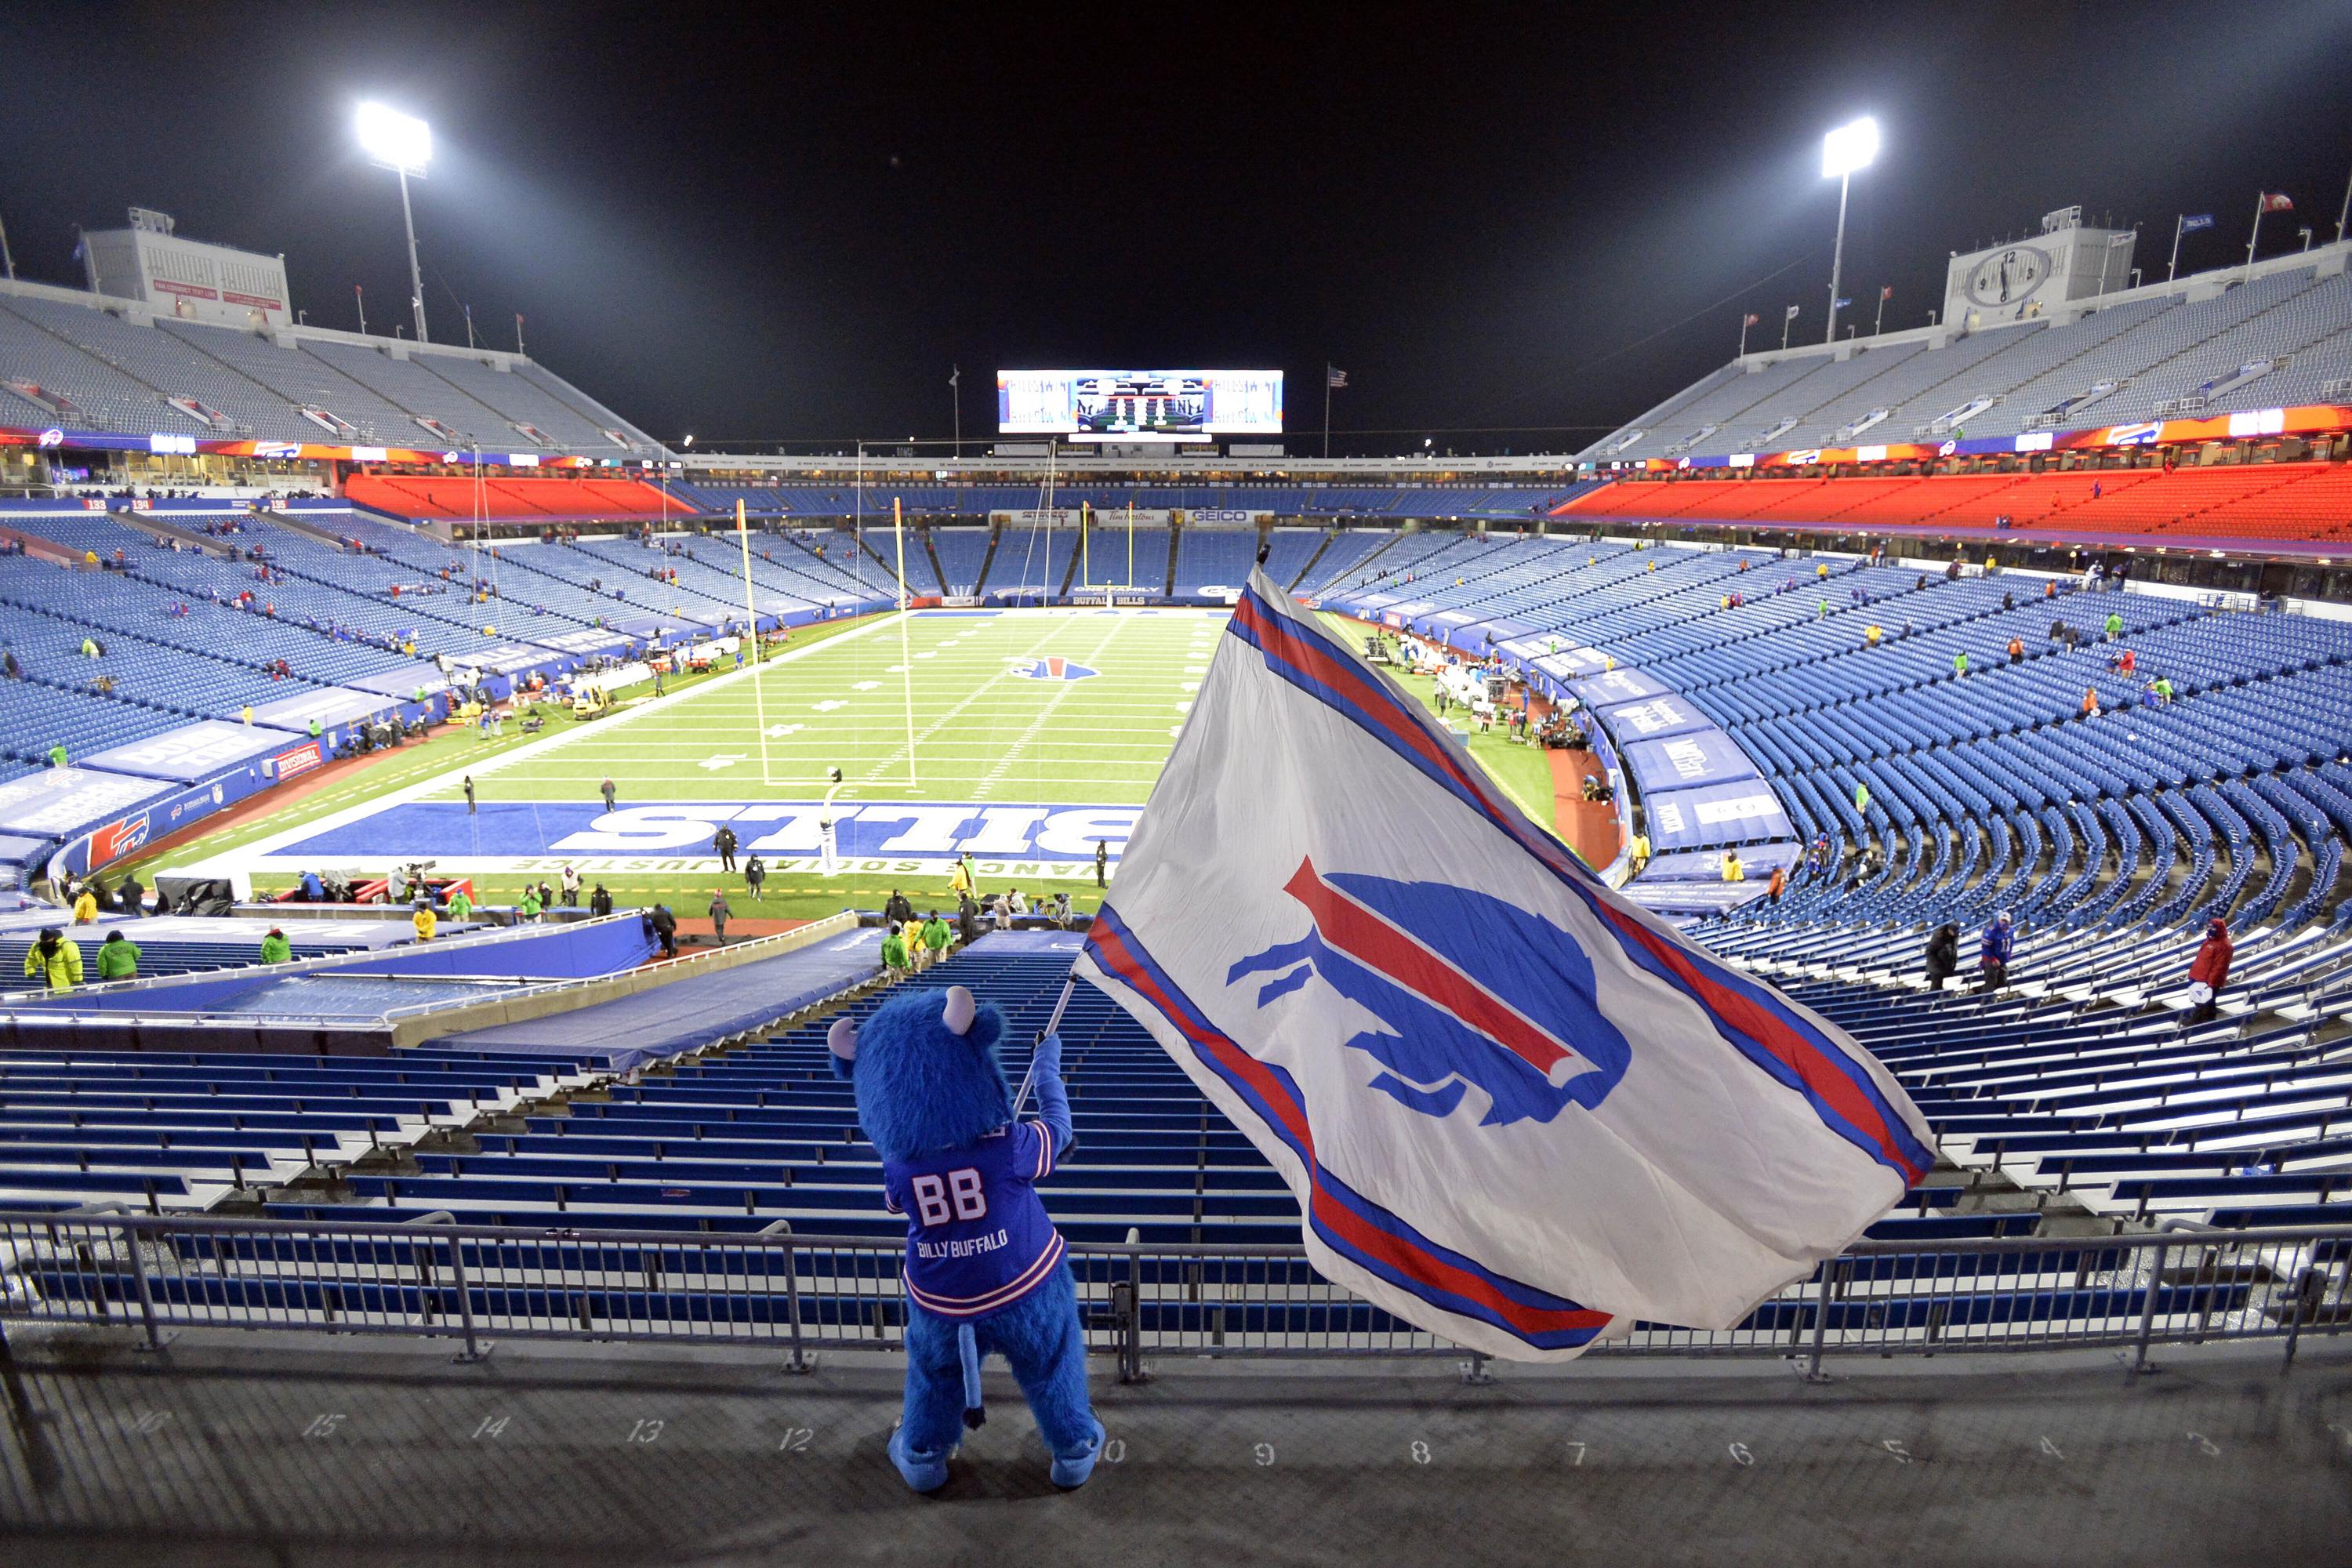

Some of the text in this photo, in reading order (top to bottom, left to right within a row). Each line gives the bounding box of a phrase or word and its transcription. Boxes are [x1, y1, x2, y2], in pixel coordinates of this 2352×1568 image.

[2187, 218, 2211, 227] BILLS
[2003, 251, 2016, 264] 12
[1980, 278, 1987, 290] 9
[2027, 268, 2033, 280] 3
[2000, 290, 2007, 303] 6
[89, 500, 106, 510] 133
[132, 500, 149, 510] 134
[270, 500, 285, 509] 135
[1109, 510, 1123, 521] Tim
[1192, 510, 1247, 521] GEICO
[278, 750, 318, 773] DIVISIONAL
[547, 804, 1141, 855] BILLS
[510, 859, 720, 870] JUSTICE
[912, 1167, 987, 1228] BB
[916, 1229, 1009, 1258] BILLY BUFFALO
[302, 1414, 347, 1437] 15
[471, 1416, 511, 1438] 14
[626, 1419, 664, 1443] 13
[779, 1428, 814, 1451] 12
[1095, 1439, 1126, 1464] 0
[1254, 1443, 1275, 1466] 9
[1411, 1440, 1432, 1464] 8
[1567, 1441, 1585, 1465] 7
[1728, 1442, 1754, 1465] 6
[1883, 1439, 1914, 1464] 5
